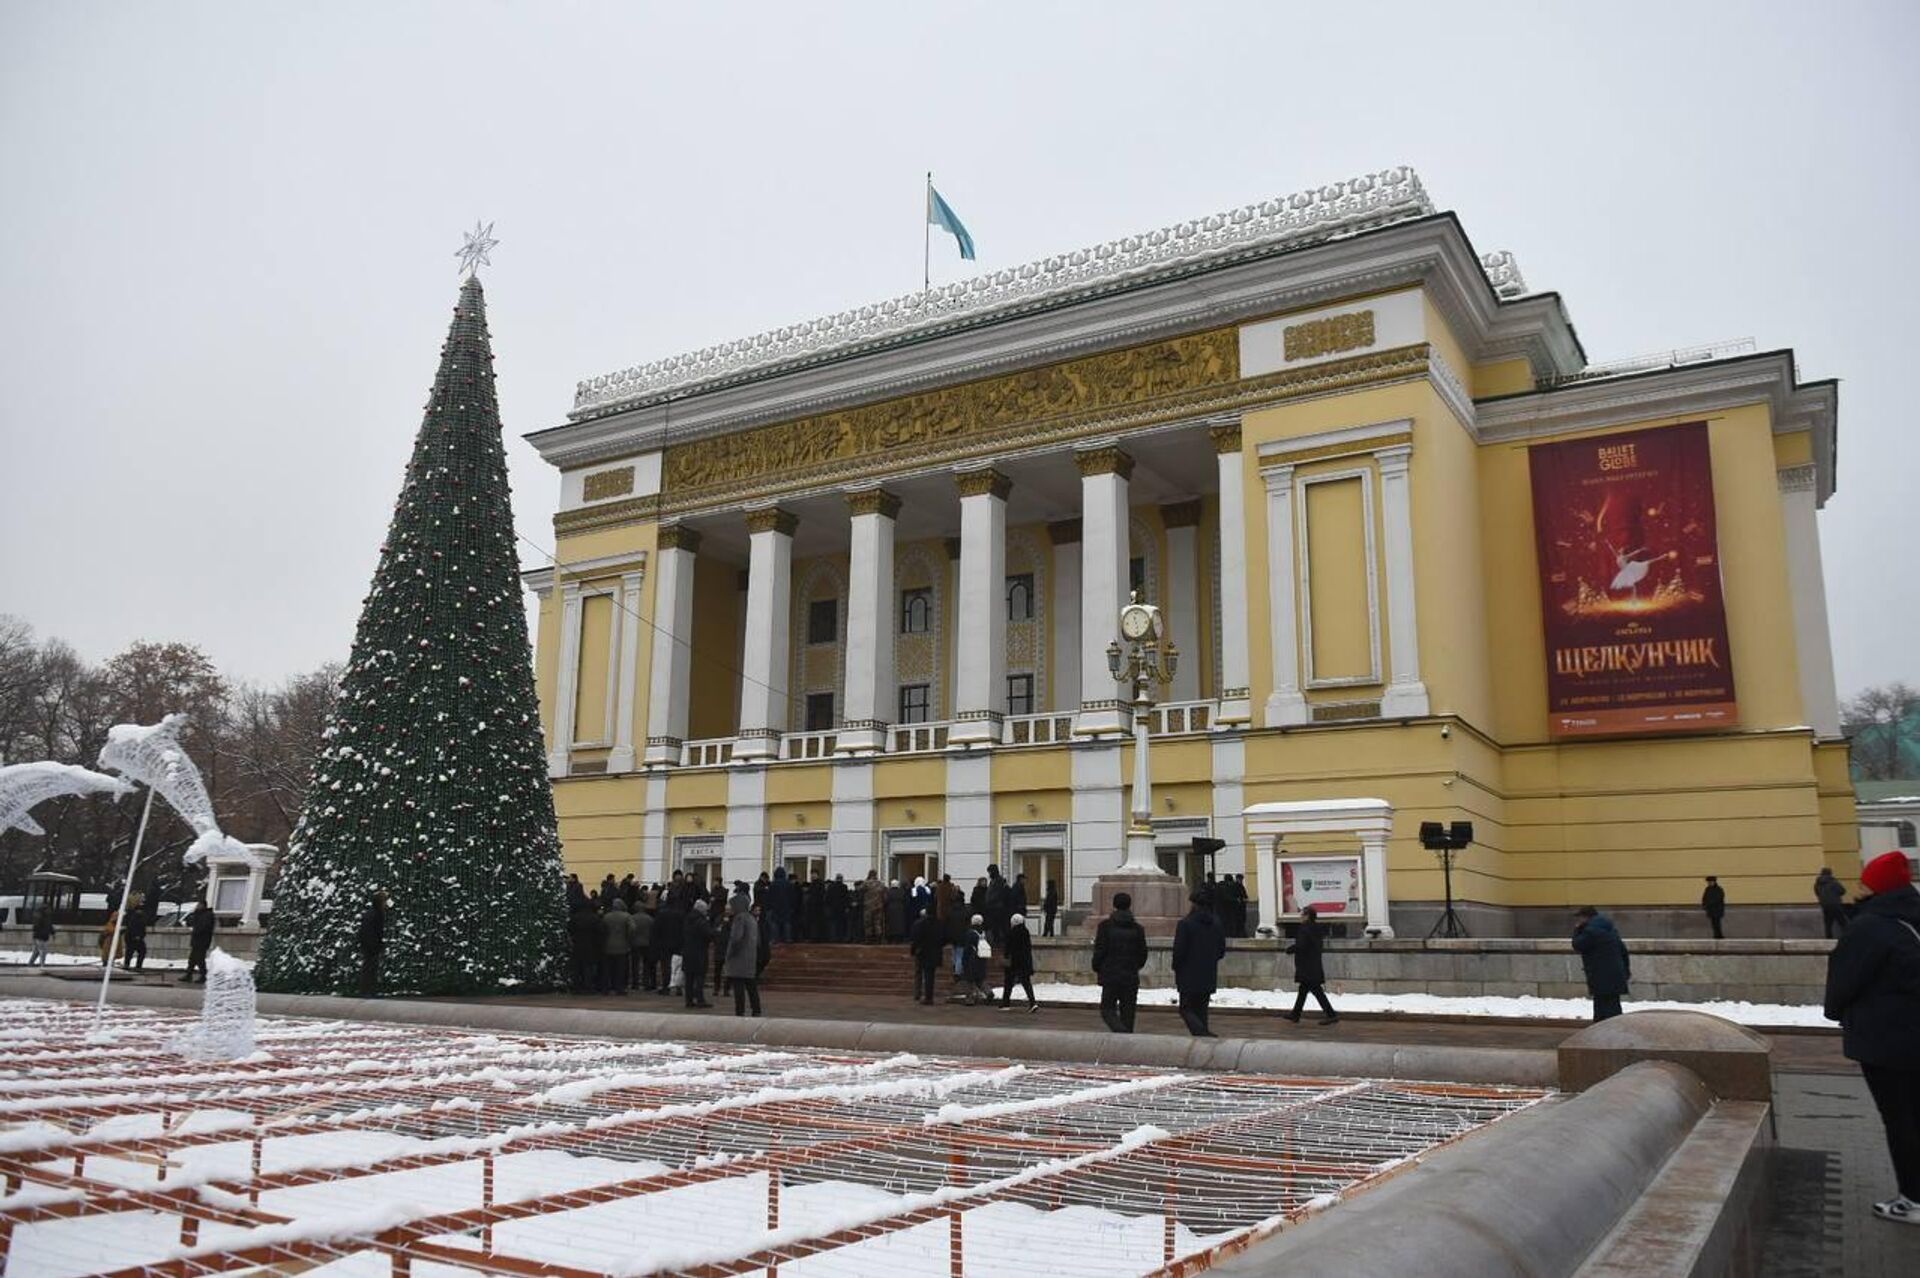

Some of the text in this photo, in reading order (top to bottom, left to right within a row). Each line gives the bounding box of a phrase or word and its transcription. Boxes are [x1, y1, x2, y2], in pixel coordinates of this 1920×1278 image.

[1598, 443, 1635, 459] BALLET
[1600, 455, 1637, 471] GLOBE
[1556, 638, 1719, 678] ЩЕЛКУНЧИК
